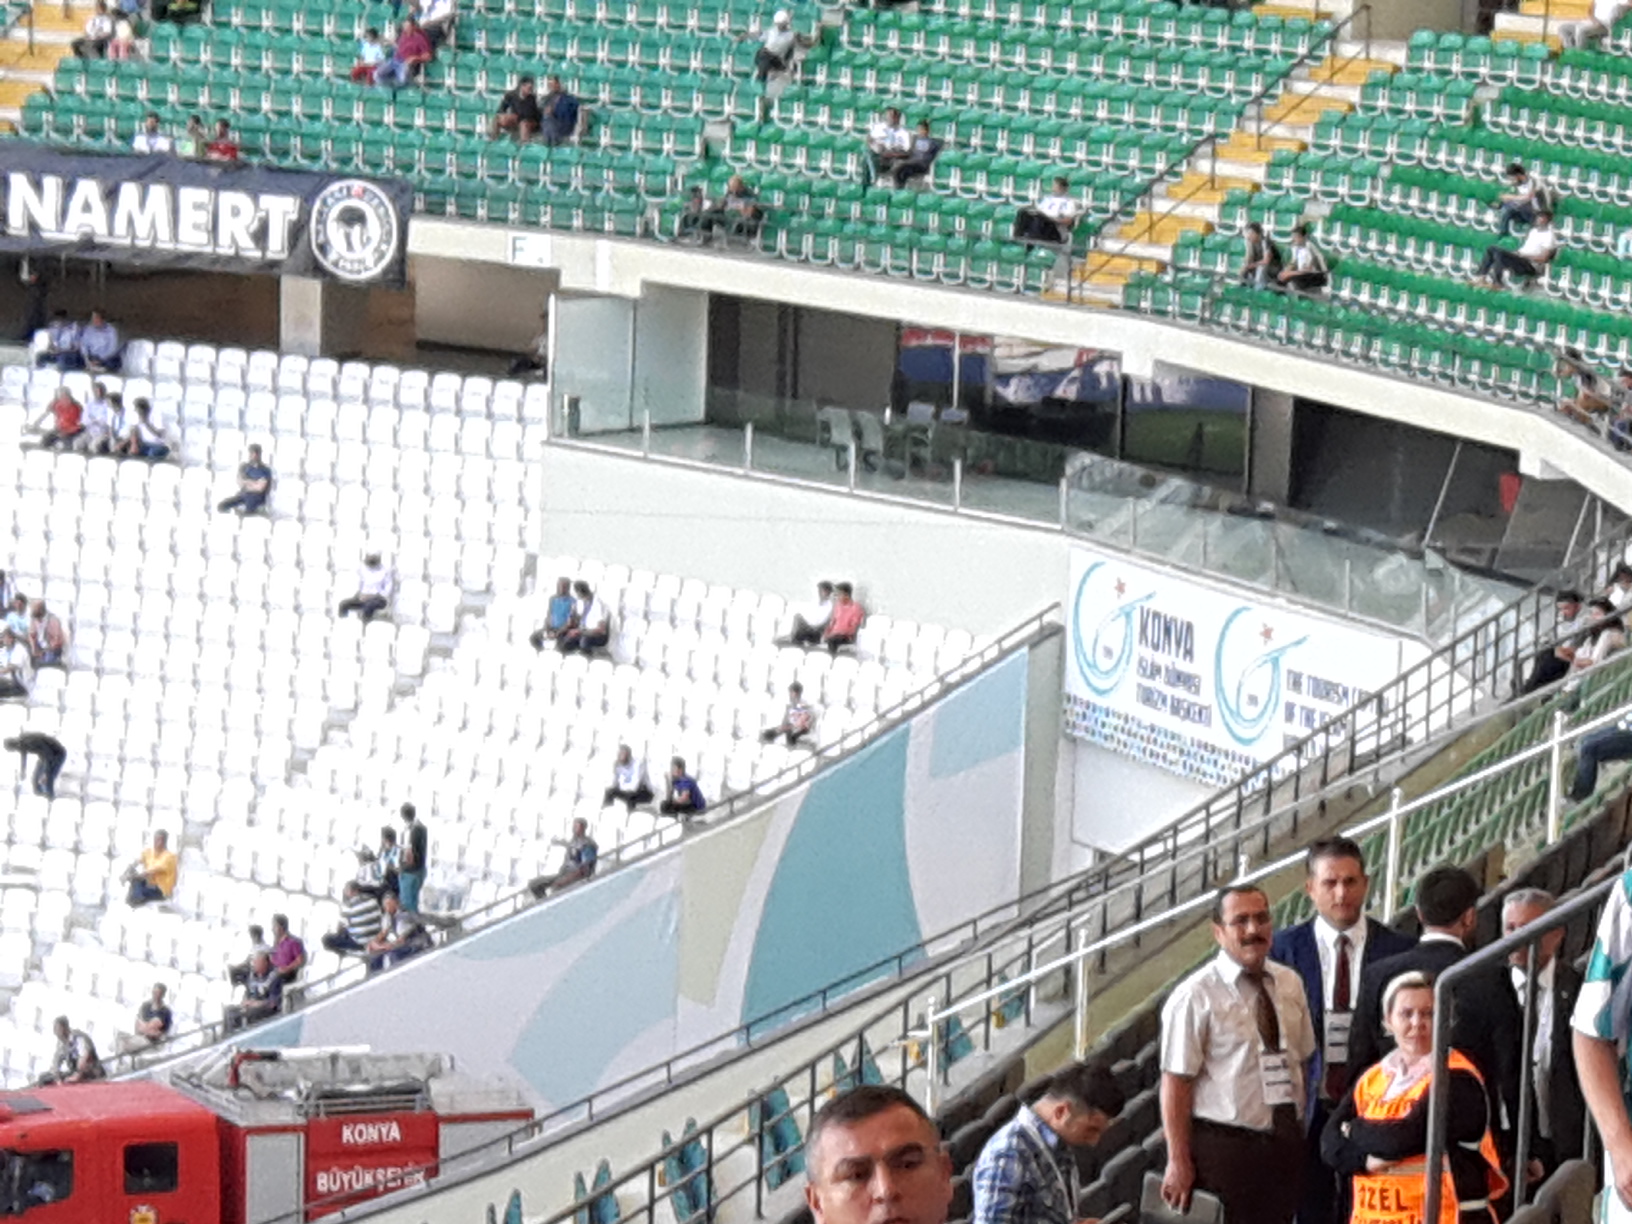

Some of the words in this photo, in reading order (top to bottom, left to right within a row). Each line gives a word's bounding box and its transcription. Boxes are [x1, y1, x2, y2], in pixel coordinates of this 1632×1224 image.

[6, 171, 300, 259] NAMERT
[1138, 605, 1195, 664] KONYA
[341, 1120, 401, 1144] KONYA
